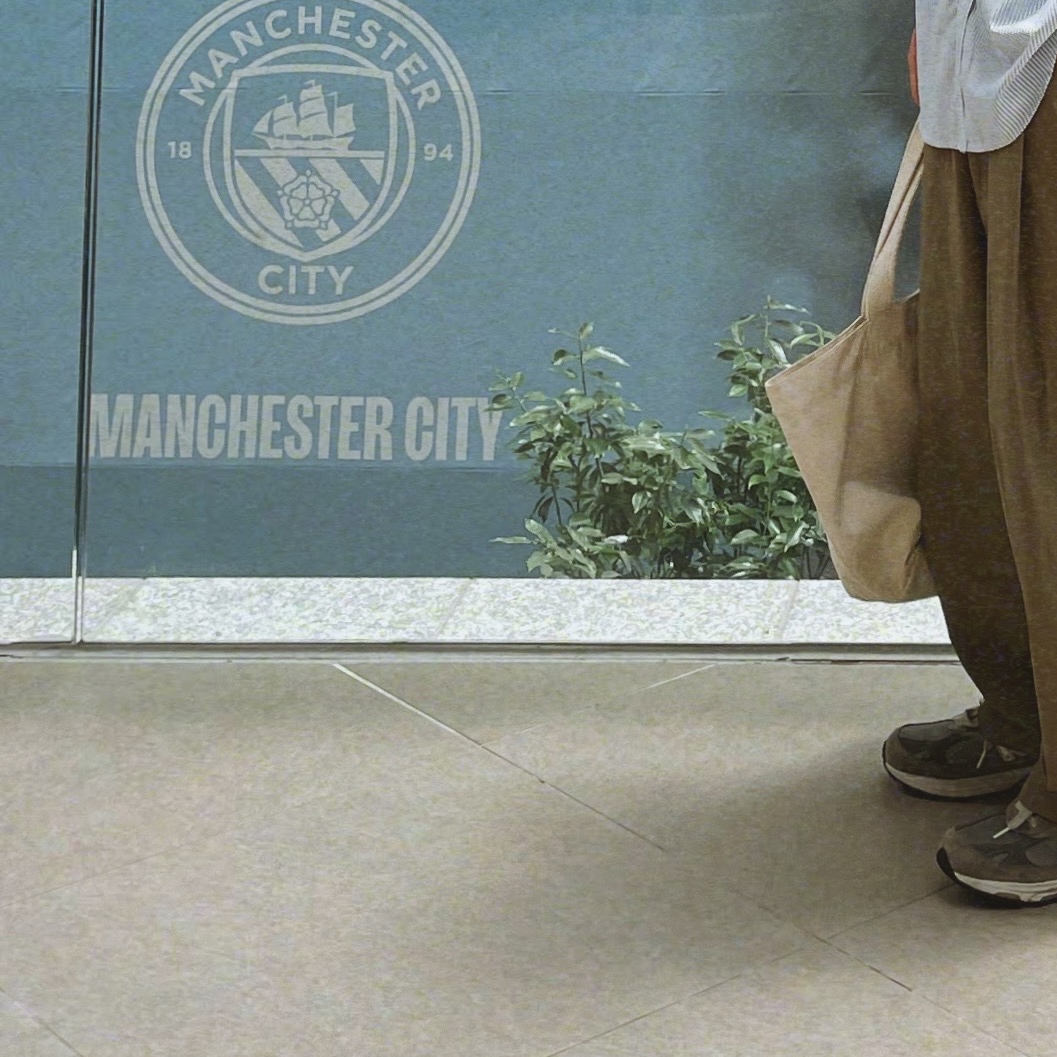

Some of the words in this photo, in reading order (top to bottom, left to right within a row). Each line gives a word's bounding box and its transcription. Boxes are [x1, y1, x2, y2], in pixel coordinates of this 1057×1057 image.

[179, 5, 442, 111] MANCHESTER
[167, 141, 192, 159] 18
[423, 143, 454, 161] 94
[257, 264, 354, 295] CITY
[90, 393, 394, 461] MANCHESTER
[405, 396, 503, 461] CITY
